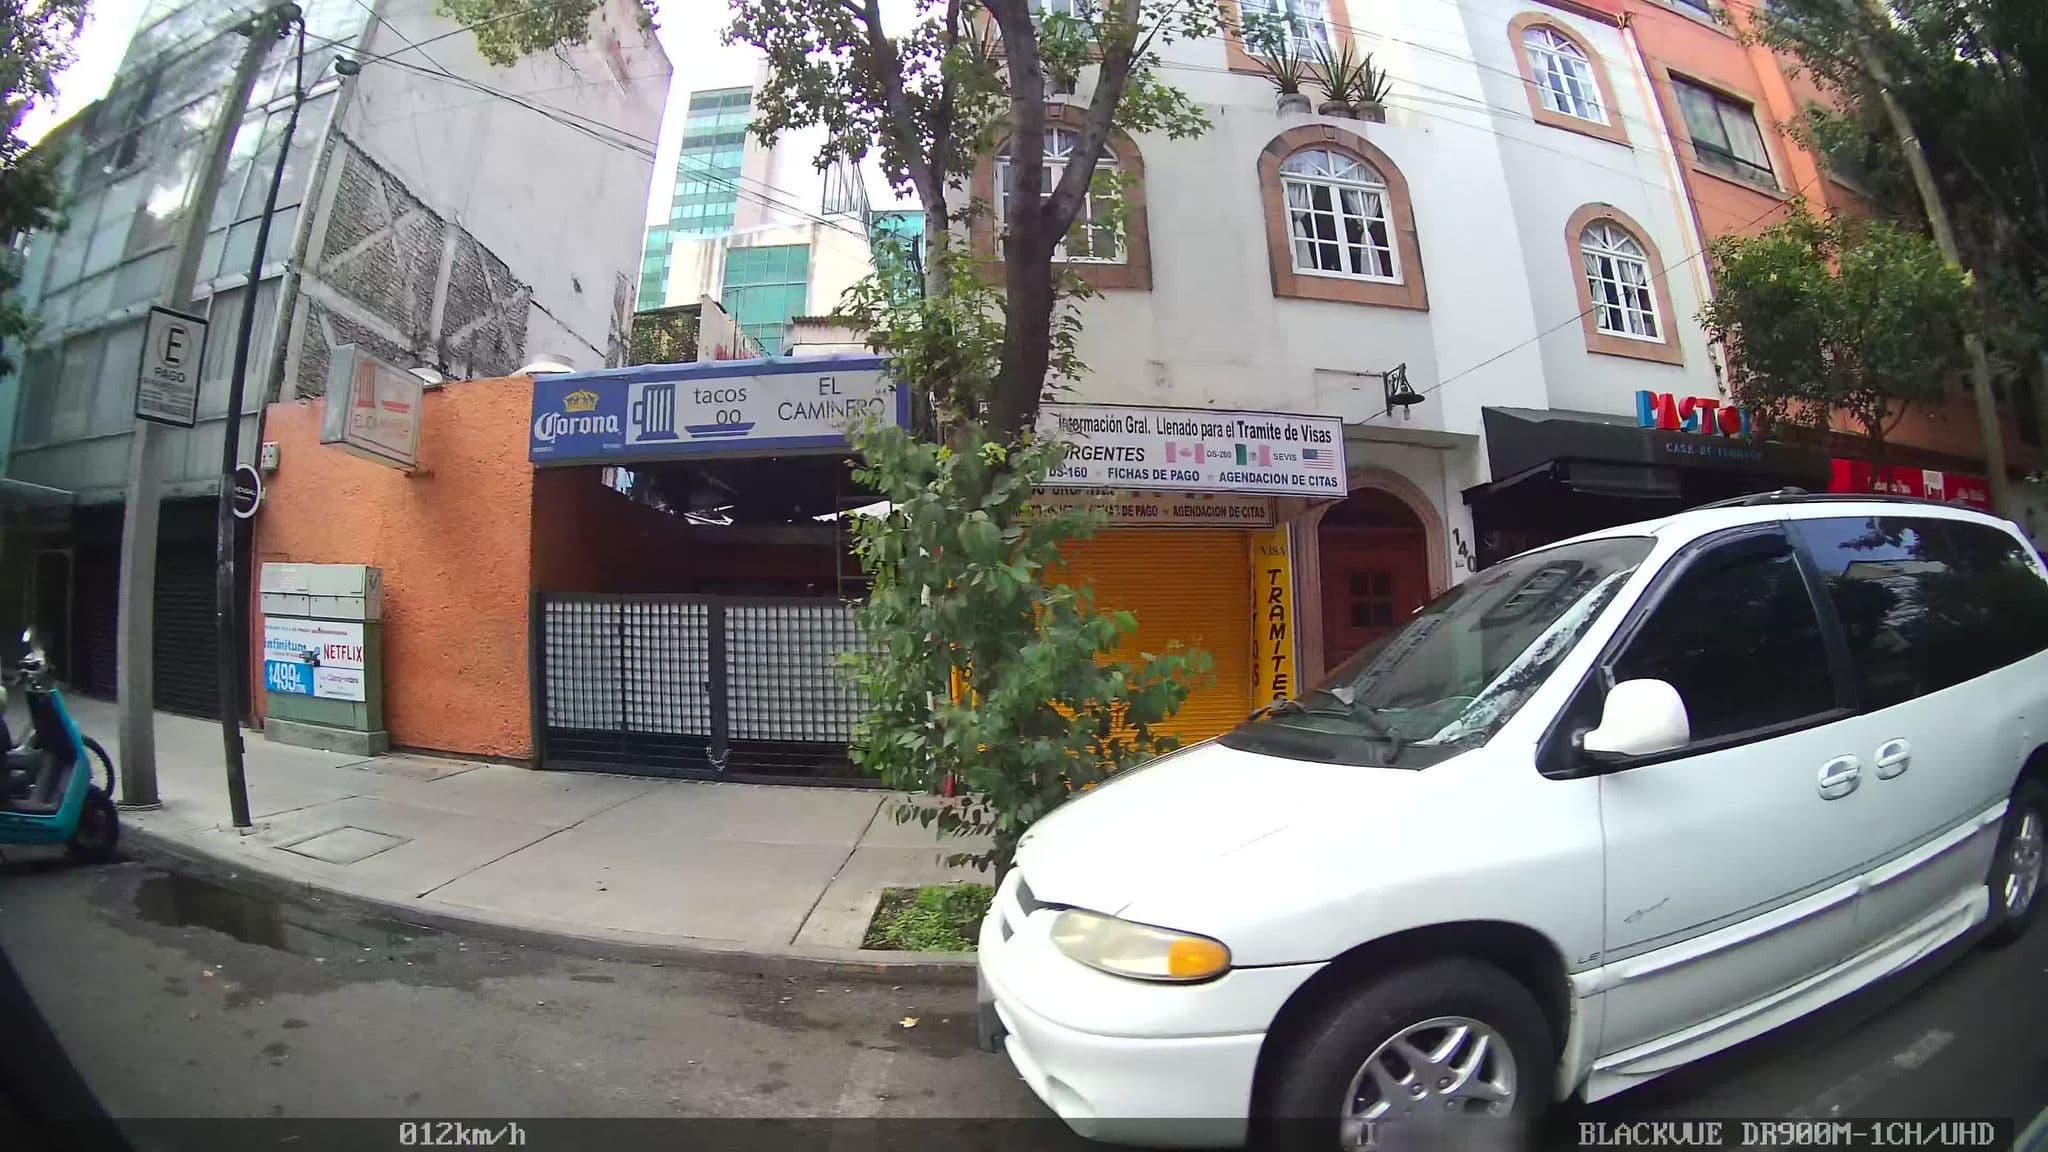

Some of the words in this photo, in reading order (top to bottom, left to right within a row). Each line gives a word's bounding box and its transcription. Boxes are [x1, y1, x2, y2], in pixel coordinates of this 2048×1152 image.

[166, 327, 184, 364] E
[694, 387, 747, 404] tacos
[819, 377, 842, 396] EL
[534, 412, 621, 443] Corona
[1125, 416, 1151, 435] Gral.
[1156, 416, 1198, 437] Llenado
[1201, 422, 1223, 441] para
[1226, 421, 1235, 438] el
[1237, 420, 1281, 440] Tramite
[1285, 423, 1298, 441] de
[1300, 424, 1332, 444] Visas
[1273, 453, 1297, 462] SEVIS
[1107, 467, 1150, 480] FICHAS
[1152, 469, 1167, 481] DE
[1170, 469, 1200, 482] PAGO
[1219, 471, 1288, 485] AGENDACION
[1292, 473, 1306, 486] DE
[1308, 475, 1338, 488] CITAS
[1122, 505, 1134, 517] DE
[1136, 505, 1158, 518] PAGO
[1229, 506, 1240, 518] DE
[1241, 506, 1265, 519] CITAS
[1452, 527, 1477, 573] 140
[323, 643, 363, 663] NETFLIX
